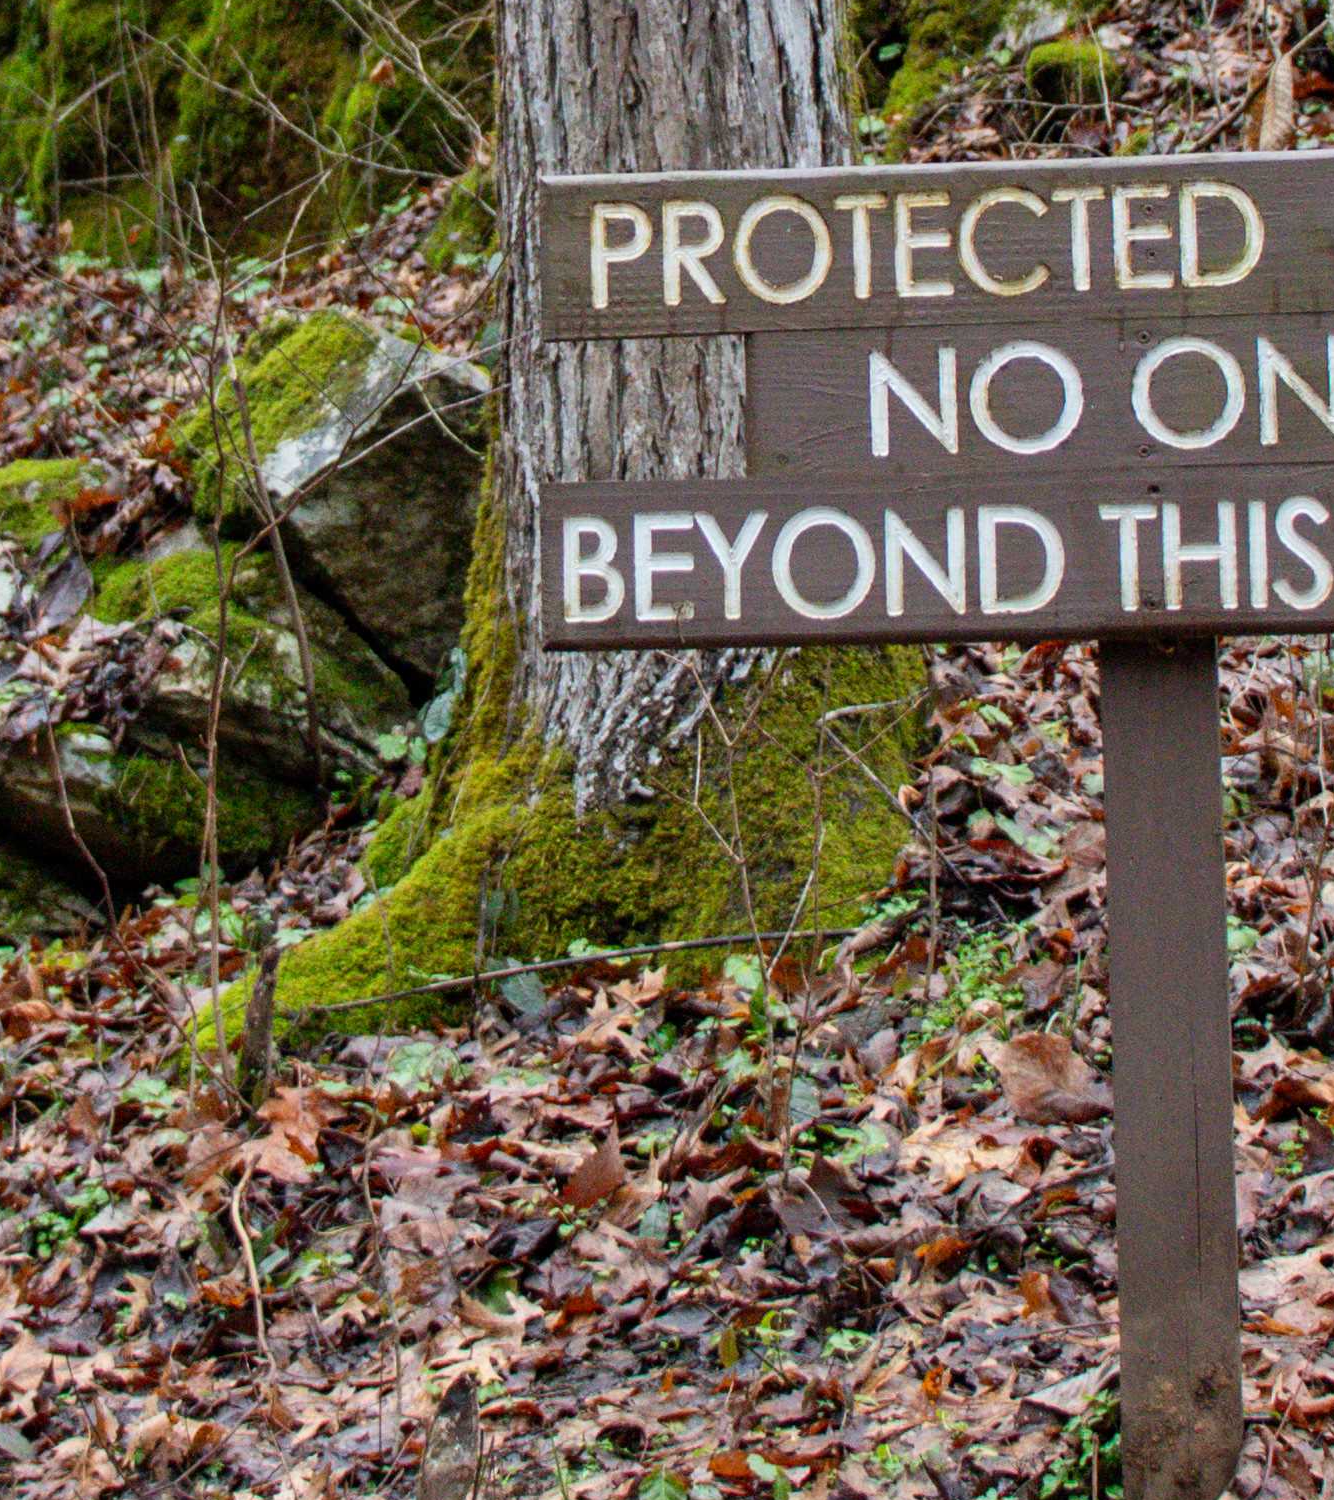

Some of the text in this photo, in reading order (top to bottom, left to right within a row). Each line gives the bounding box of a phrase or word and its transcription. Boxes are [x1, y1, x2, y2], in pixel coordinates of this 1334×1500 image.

[589, 179, 1264, 309] PROTECTED
[869, 340, 1085, 458] NO
[562, 504, 1065, 623] BEYOND
[1099, 495, 1334, 612] THIS
